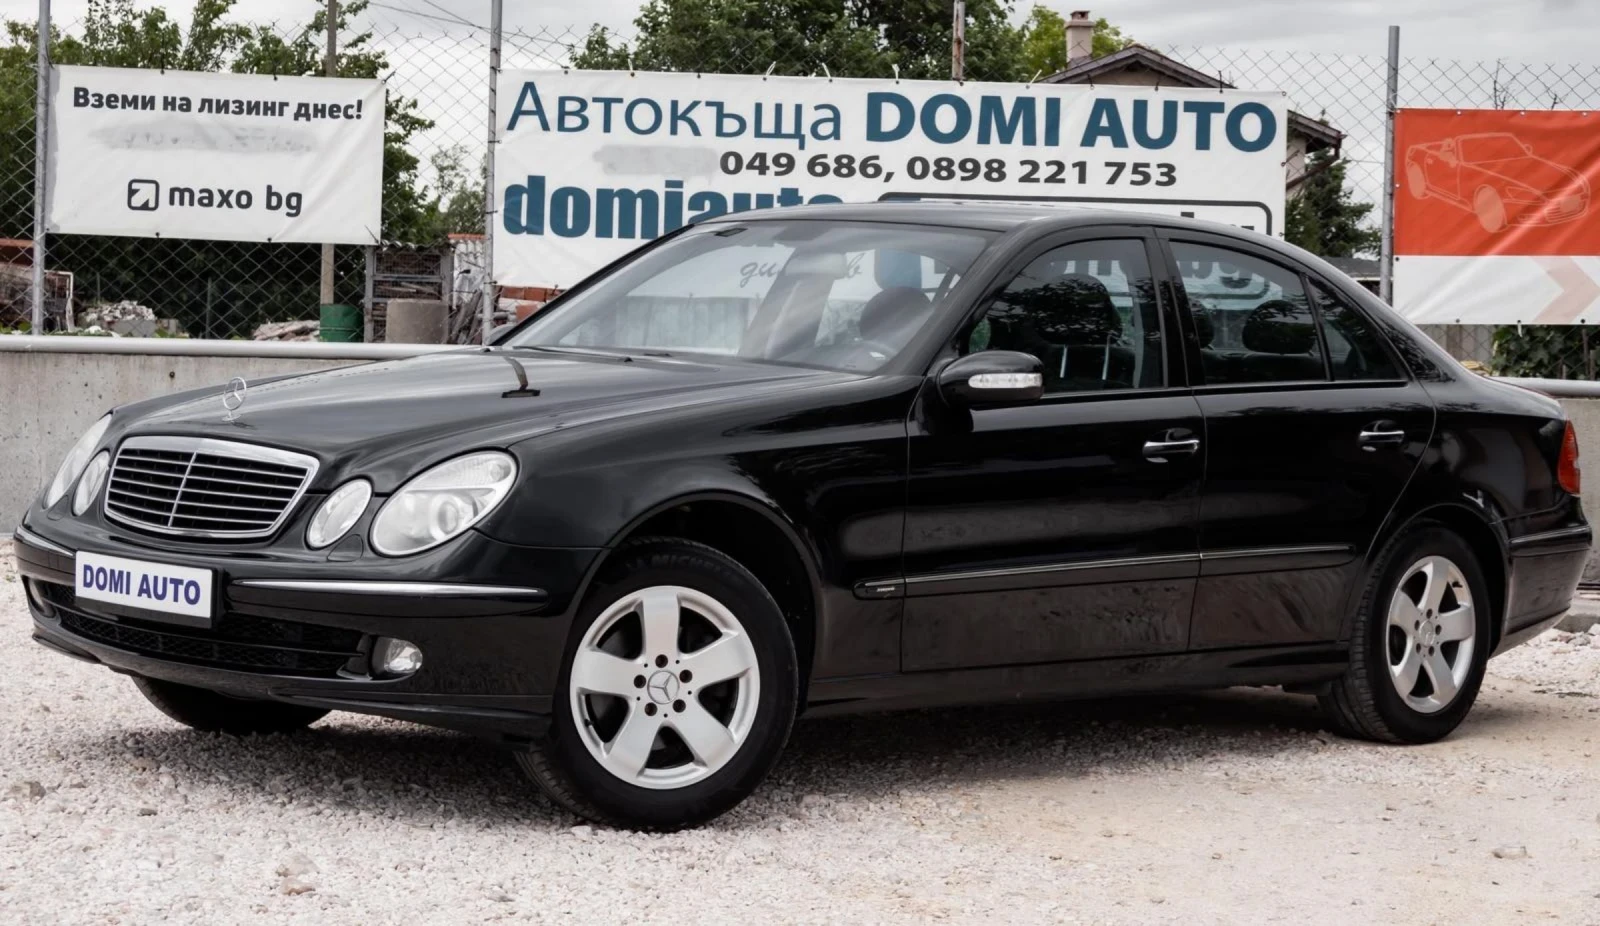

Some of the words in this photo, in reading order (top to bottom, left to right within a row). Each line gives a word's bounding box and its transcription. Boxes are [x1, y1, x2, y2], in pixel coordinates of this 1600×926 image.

[73, 86, 155, 111] Вземи
[162, 95, 192, 113] на
[198, 97, 289, 117] лизинг
[294, 99, 363, 122] днес!
[507, 81, 841, 150] Автокъща
[866, 91, 1061, 147] DOMI
[1080, 90, 1277, 153] AUTO
[720, 150, 796, 177] 049
[806, 153, 895, 183] 686,
[906, 155, 1007, 183] 0898
[1018, 159, 1087, 185] 221
[1104, 161, 1177, 187] 753
[169, 186, 253, 210] maxo
[265, 184, 303, 218] bg
[503, 175, 843, 240] domia
[83, 564, 131, 596] DOMI
[137, 573, 201, 606] AUTO
